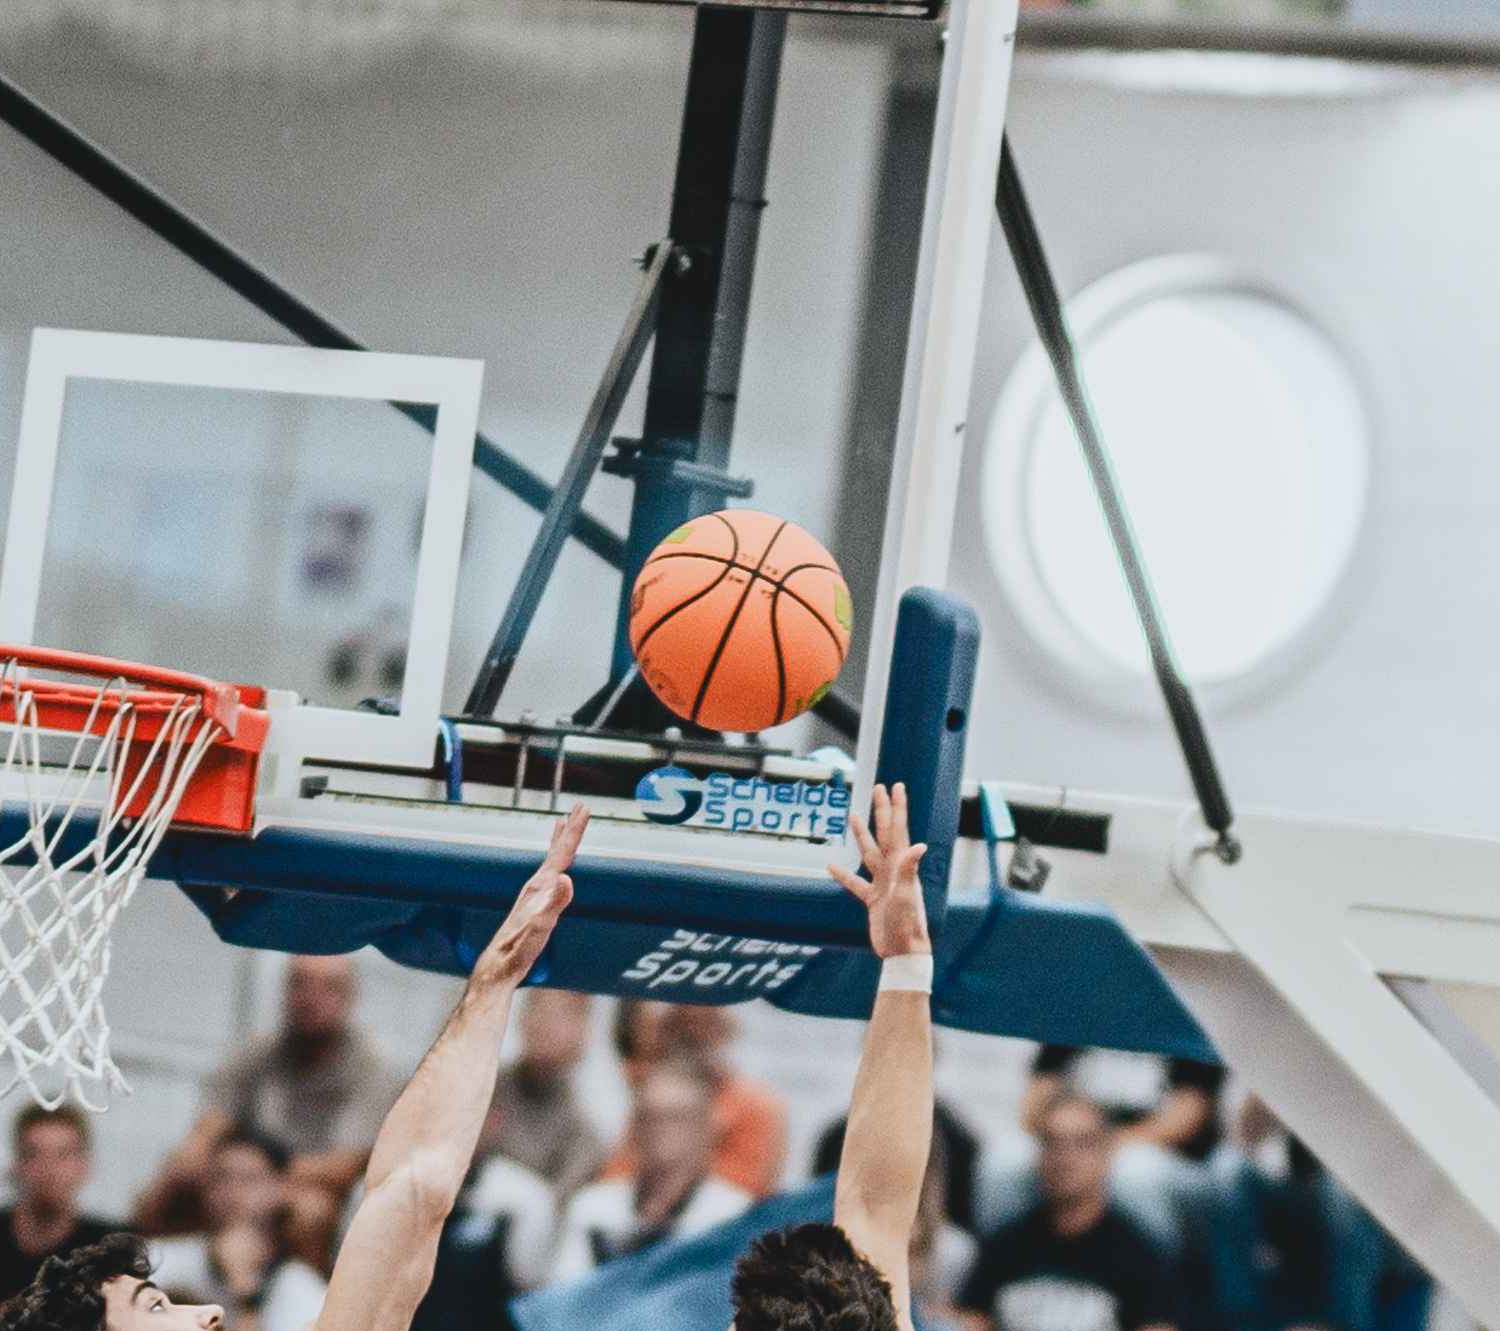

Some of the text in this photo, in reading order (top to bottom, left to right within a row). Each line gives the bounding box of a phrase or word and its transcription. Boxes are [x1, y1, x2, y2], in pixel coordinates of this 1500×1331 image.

[706, 772, 851, 809] Schelde
[704, 800, 848, 836] Sports
[623, 949, 804, 989] Sports
